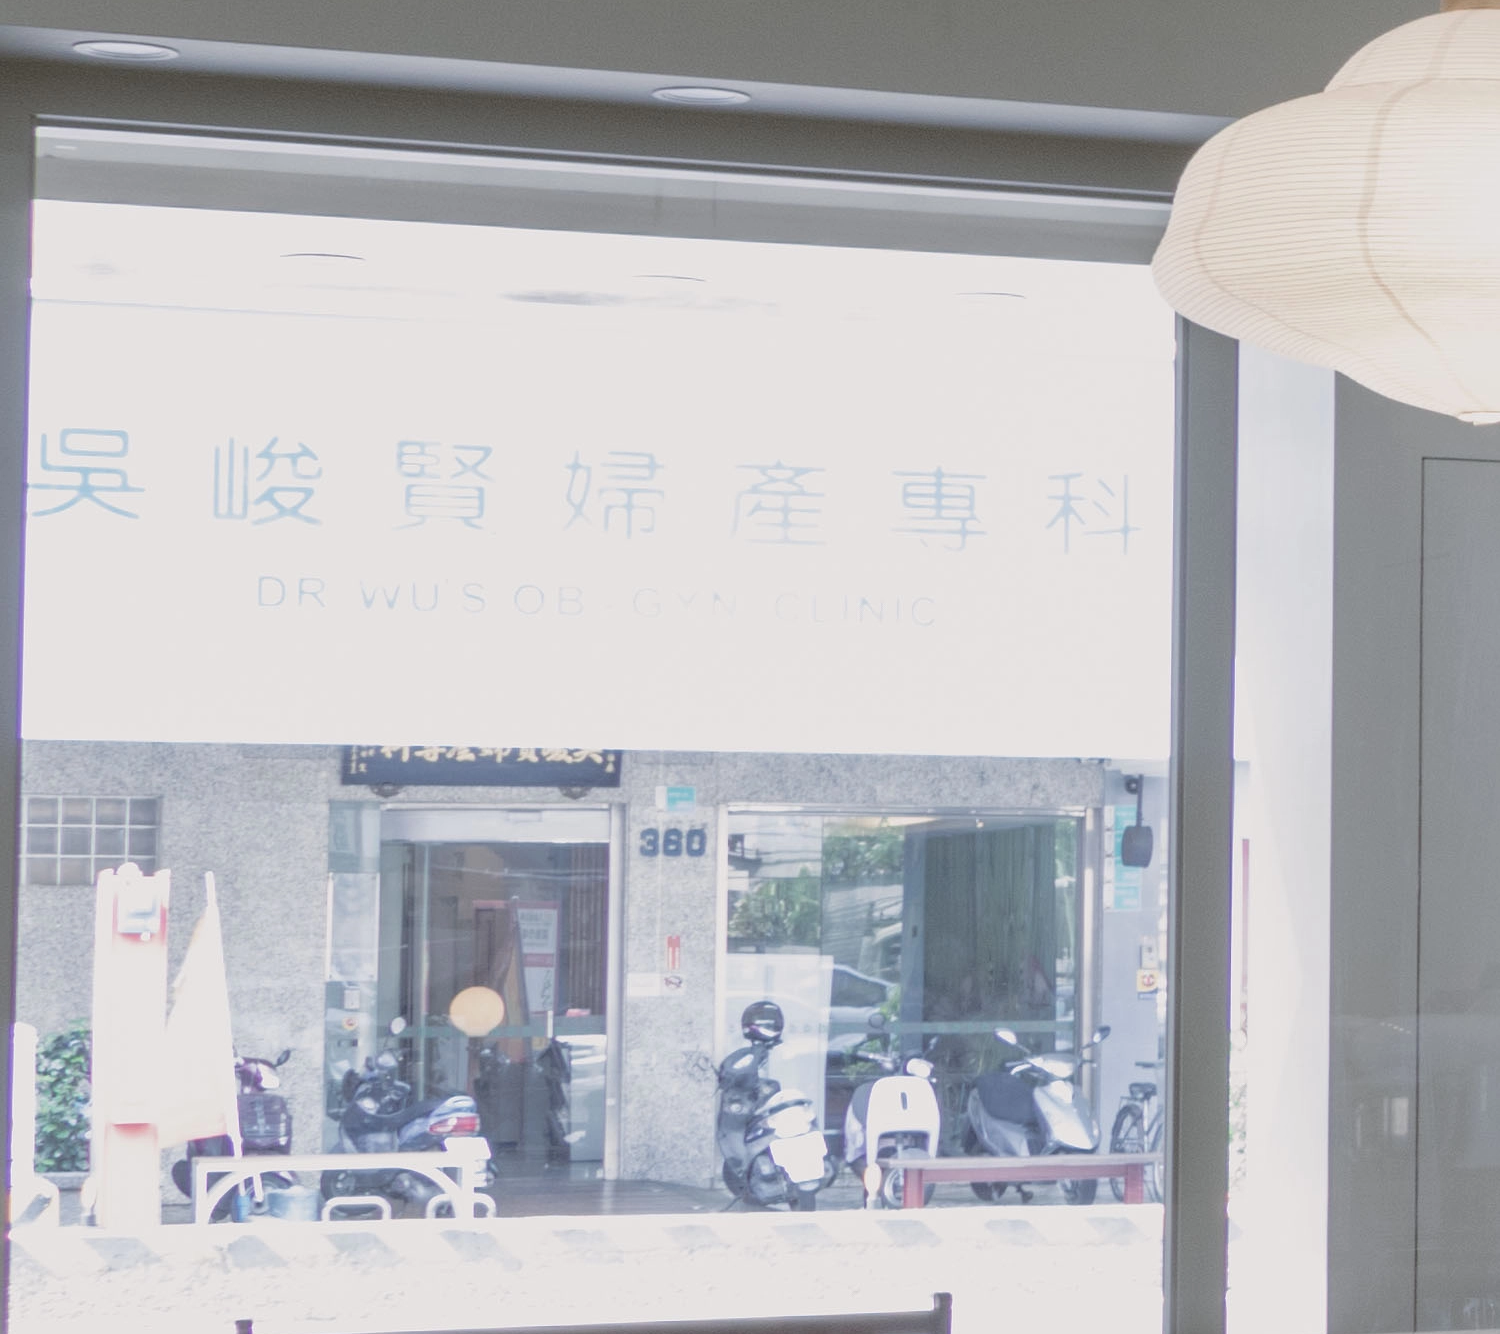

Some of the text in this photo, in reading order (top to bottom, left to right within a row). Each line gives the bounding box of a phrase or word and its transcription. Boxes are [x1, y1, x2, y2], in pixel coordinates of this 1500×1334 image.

[27, 427, 1142, 555] 吳峻賢婦產專科
[256, 574, 328, 609] DR
[358, 577, 488, 614] WU'S
[772, 592, 938, 628] CLINIC
